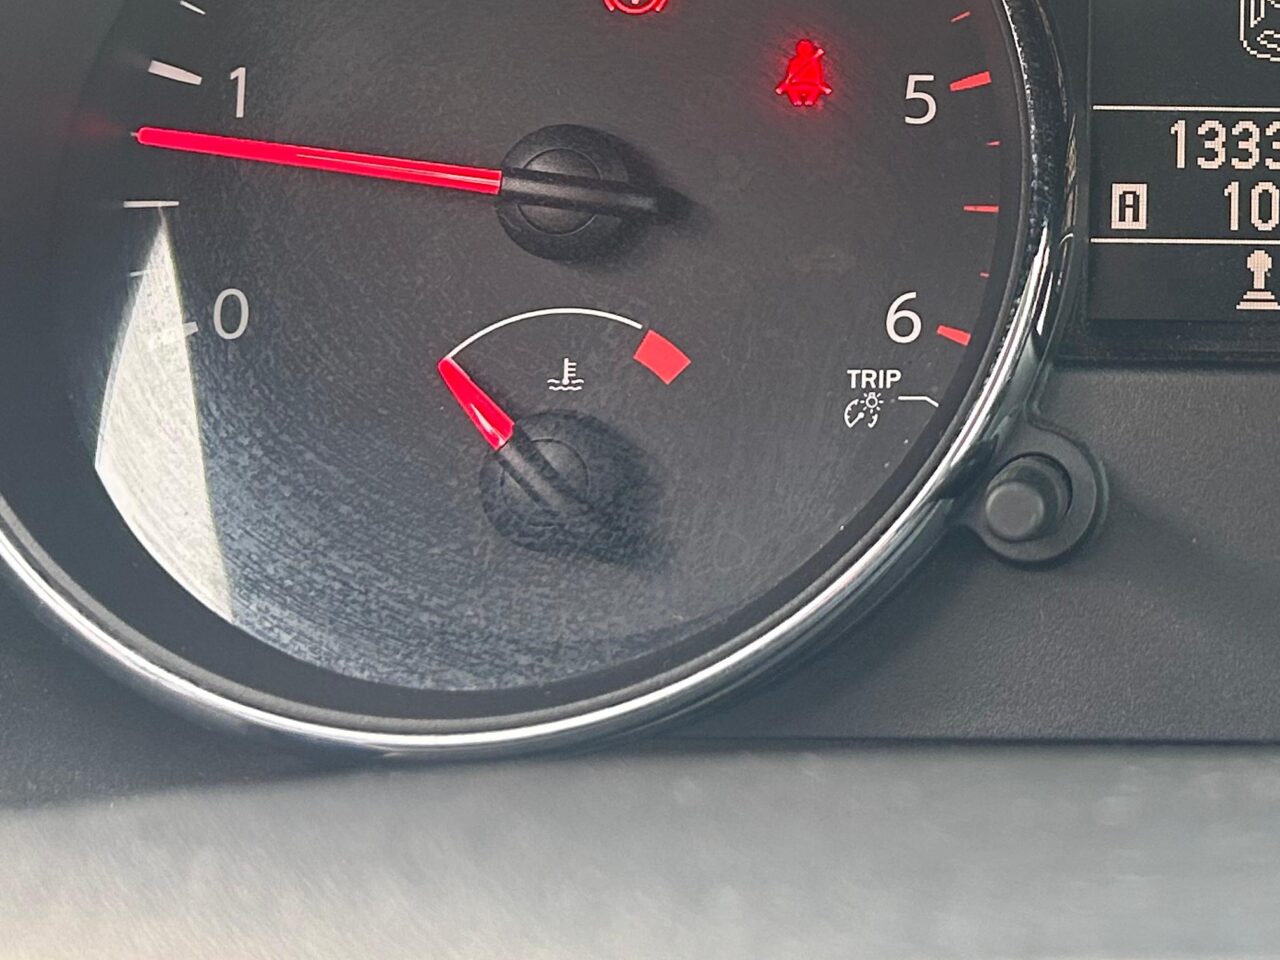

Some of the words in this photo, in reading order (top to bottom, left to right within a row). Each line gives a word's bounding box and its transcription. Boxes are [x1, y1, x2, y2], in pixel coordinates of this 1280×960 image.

[229, 67, 246, 118] 1
[904, 74, 937, 125] 5
[213, 288, 249, 340] 0
[885, 291, 922, 344] 6
[846, 369, 902, 390] TRIP
